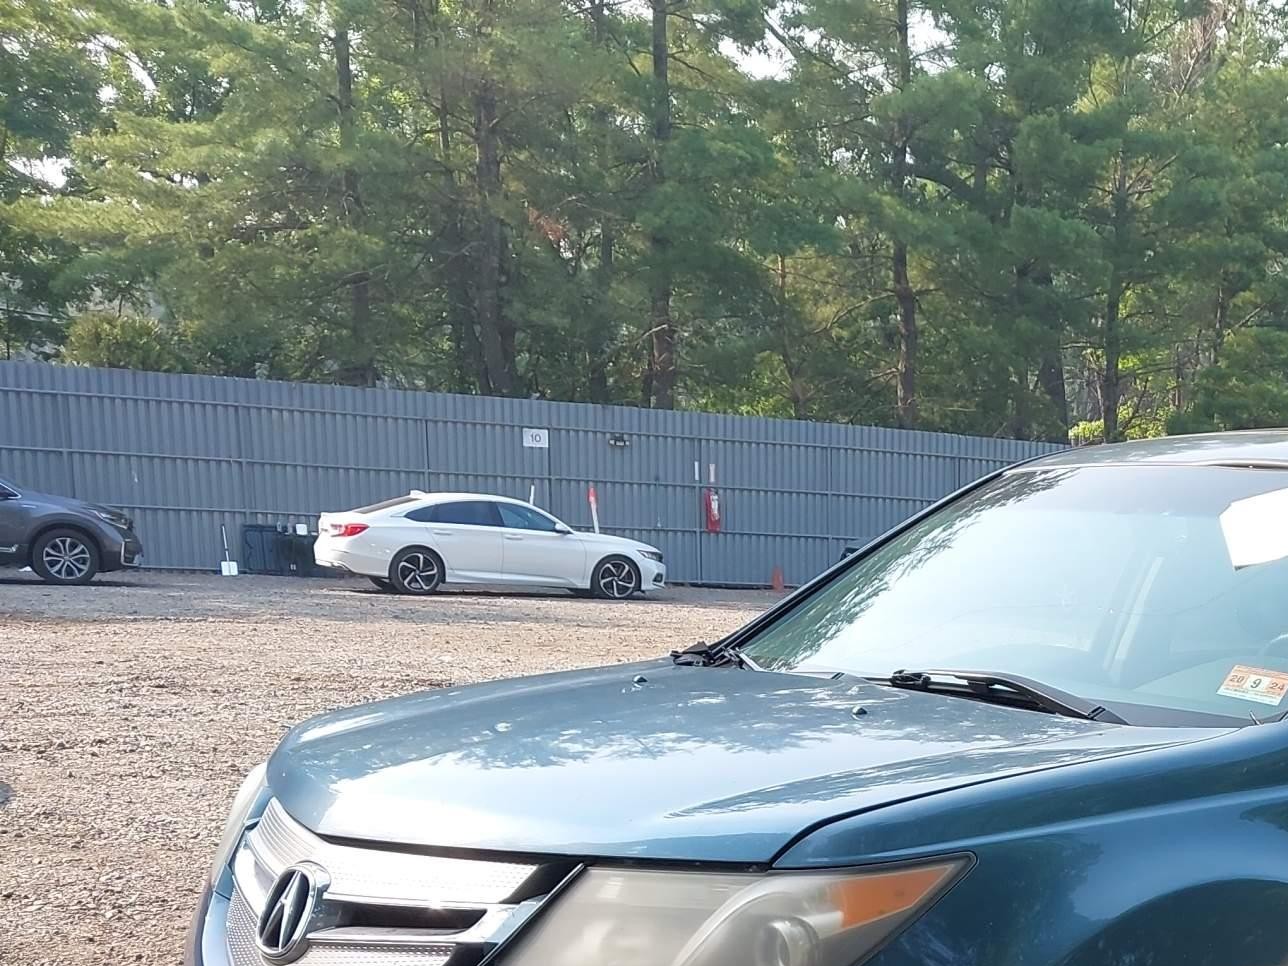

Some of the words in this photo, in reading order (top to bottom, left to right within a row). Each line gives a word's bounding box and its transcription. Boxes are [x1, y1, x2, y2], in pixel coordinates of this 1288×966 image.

[530, 433, 541, 443] 10
[1229, 674, 1245, 683] 20
[1250, 678, 1262, 689] 9
[1269, 681, 1285, 691] 24
